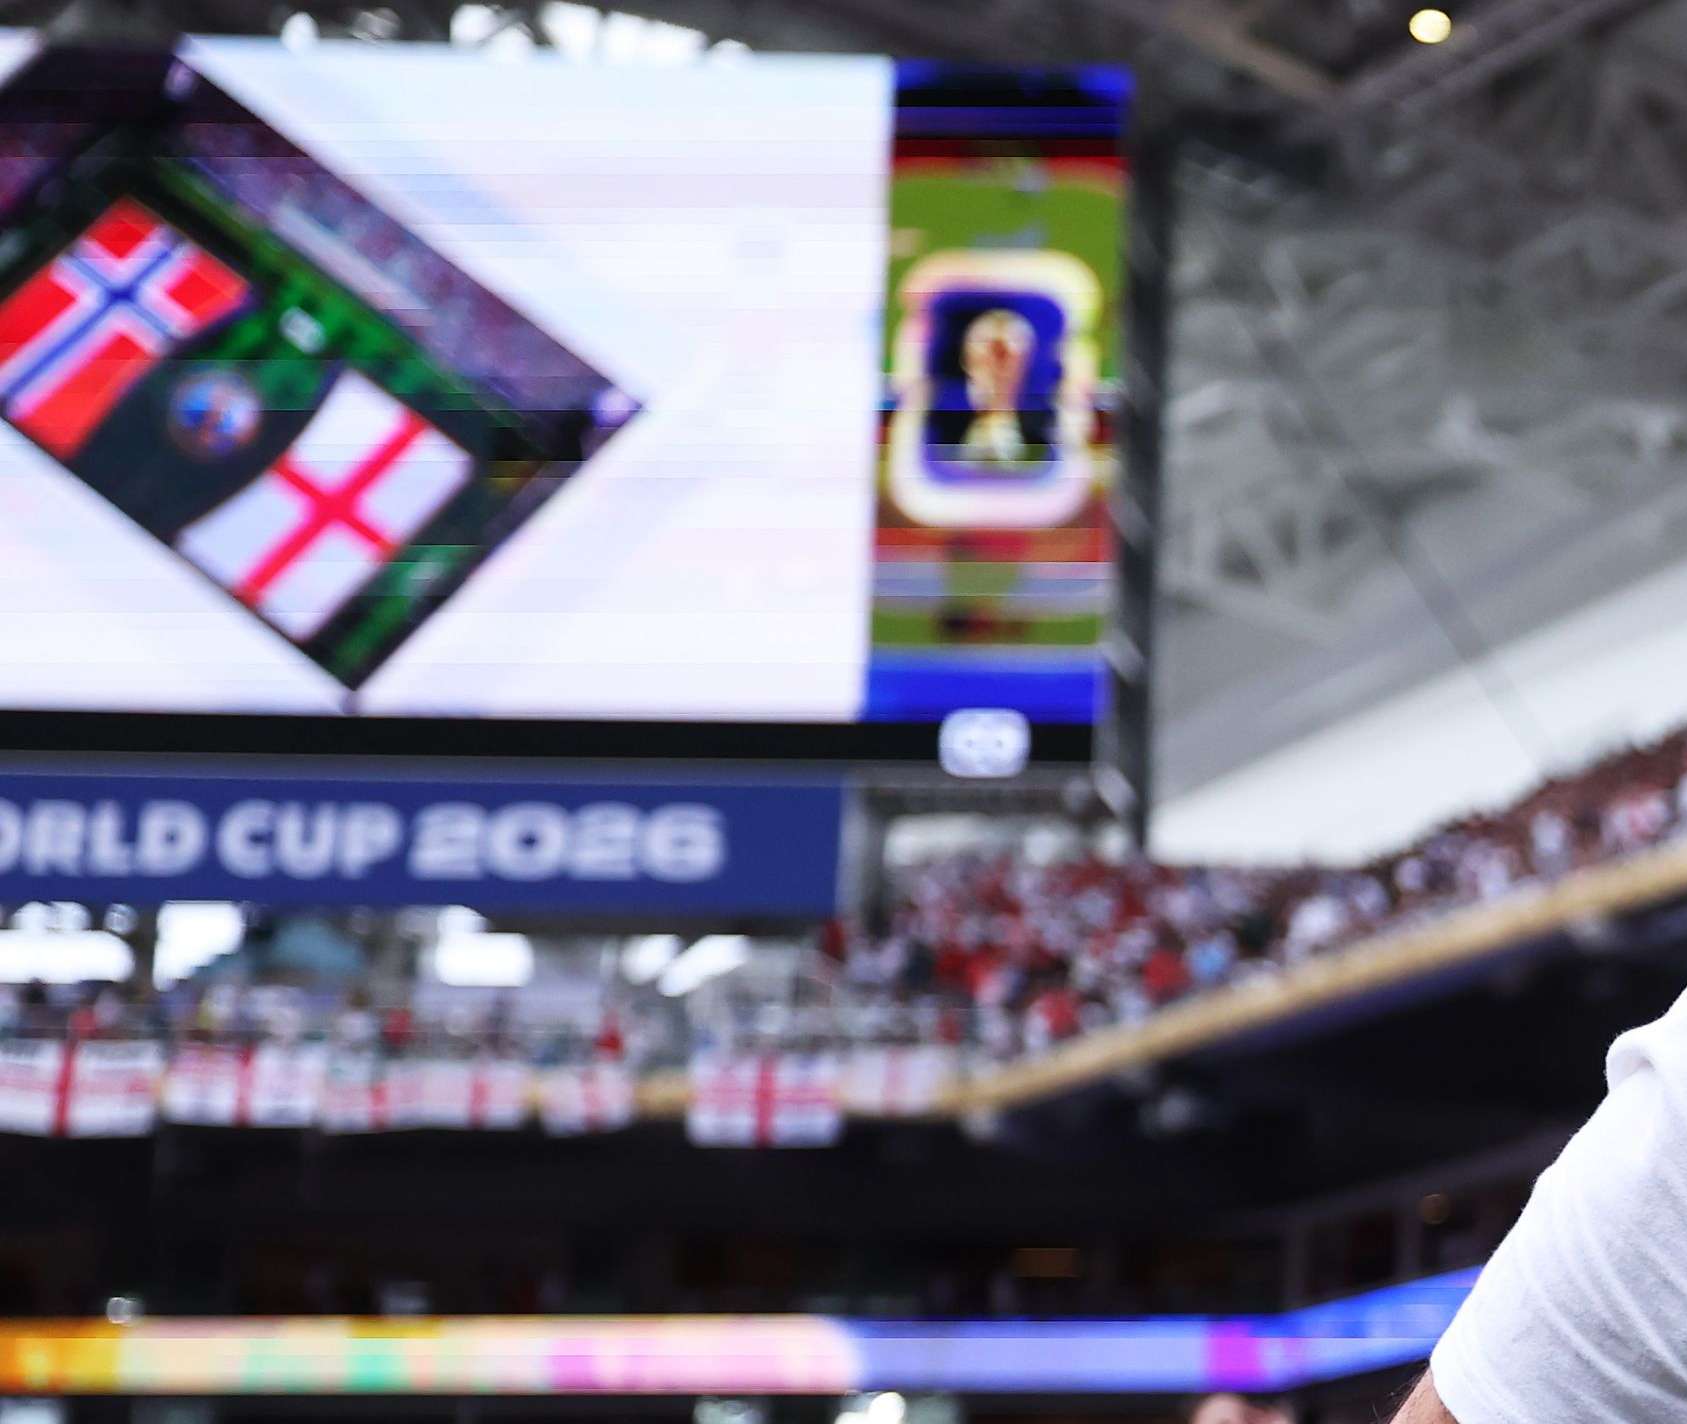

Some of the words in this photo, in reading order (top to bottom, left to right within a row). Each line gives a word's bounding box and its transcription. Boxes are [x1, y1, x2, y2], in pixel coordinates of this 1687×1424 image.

[0, 799, 206, 877] RLD
[217, 801, 400, 878] CUP
[409, 803, 725, 882] 2026
